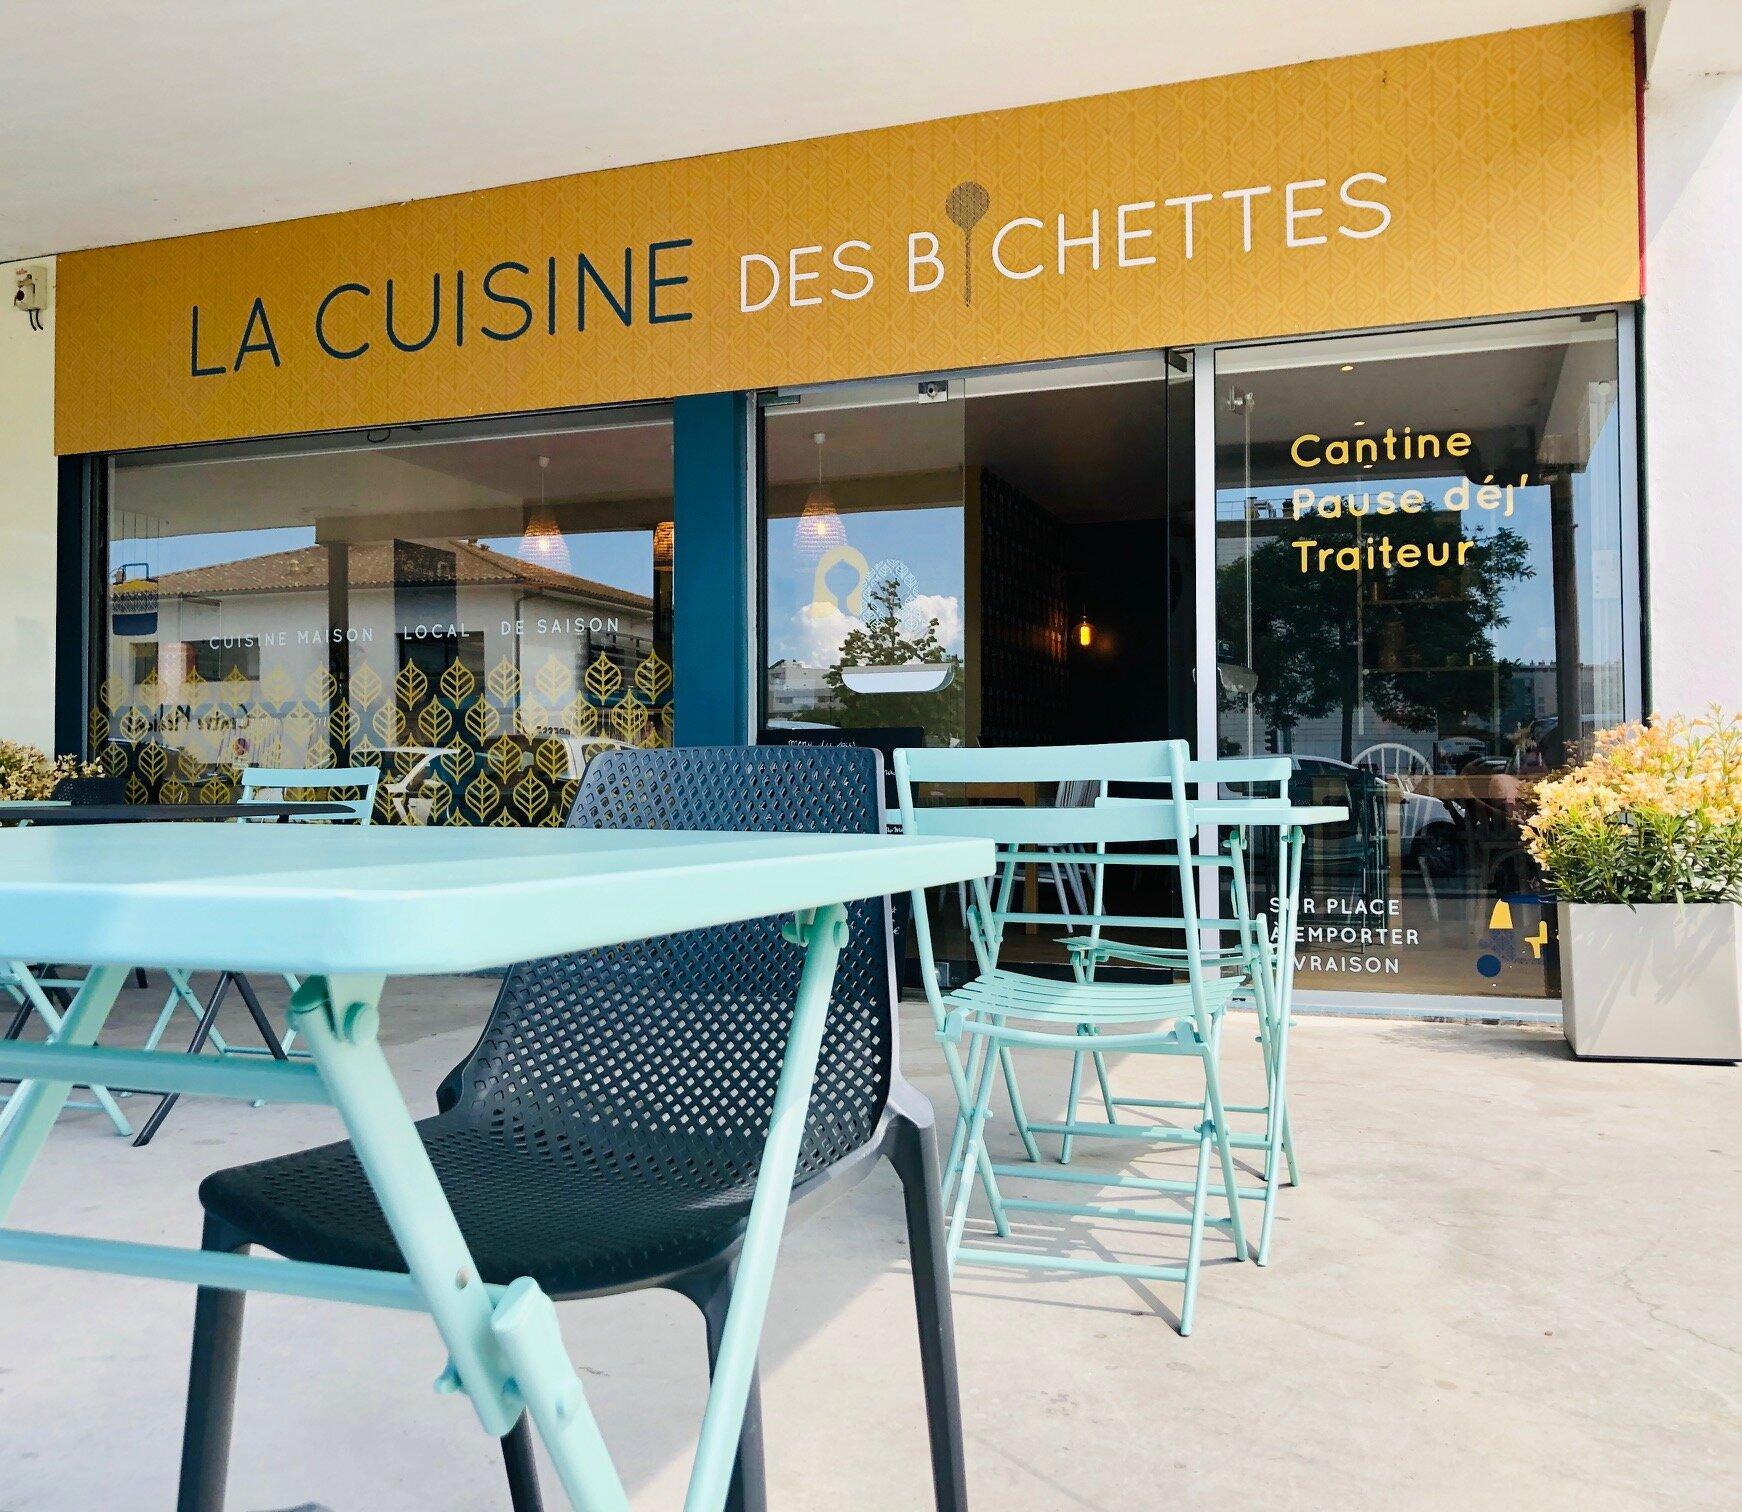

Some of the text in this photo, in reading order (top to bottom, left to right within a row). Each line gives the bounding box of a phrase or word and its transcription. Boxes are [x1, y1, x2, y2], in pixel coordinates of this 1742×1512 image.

[190, 296, 282, 378] LA
[315, 238, 694, 360] CUISINE
[740, 239, 874, 313] DES
[1291, 428, 1472, 467] Cantine
[1292, 474, 1529, 521] Pause déj'
[1291, 536, 1475, 573] Traiteur
[209, 617, 619, 650] CUISINE MAISON LOCAL DE SAISON
[1269, 896, 1400, 916] SR PLACE
[1295, 926, 1419, 945] EMPORTER
[1293, 955, 1399, 974] VRAISON
